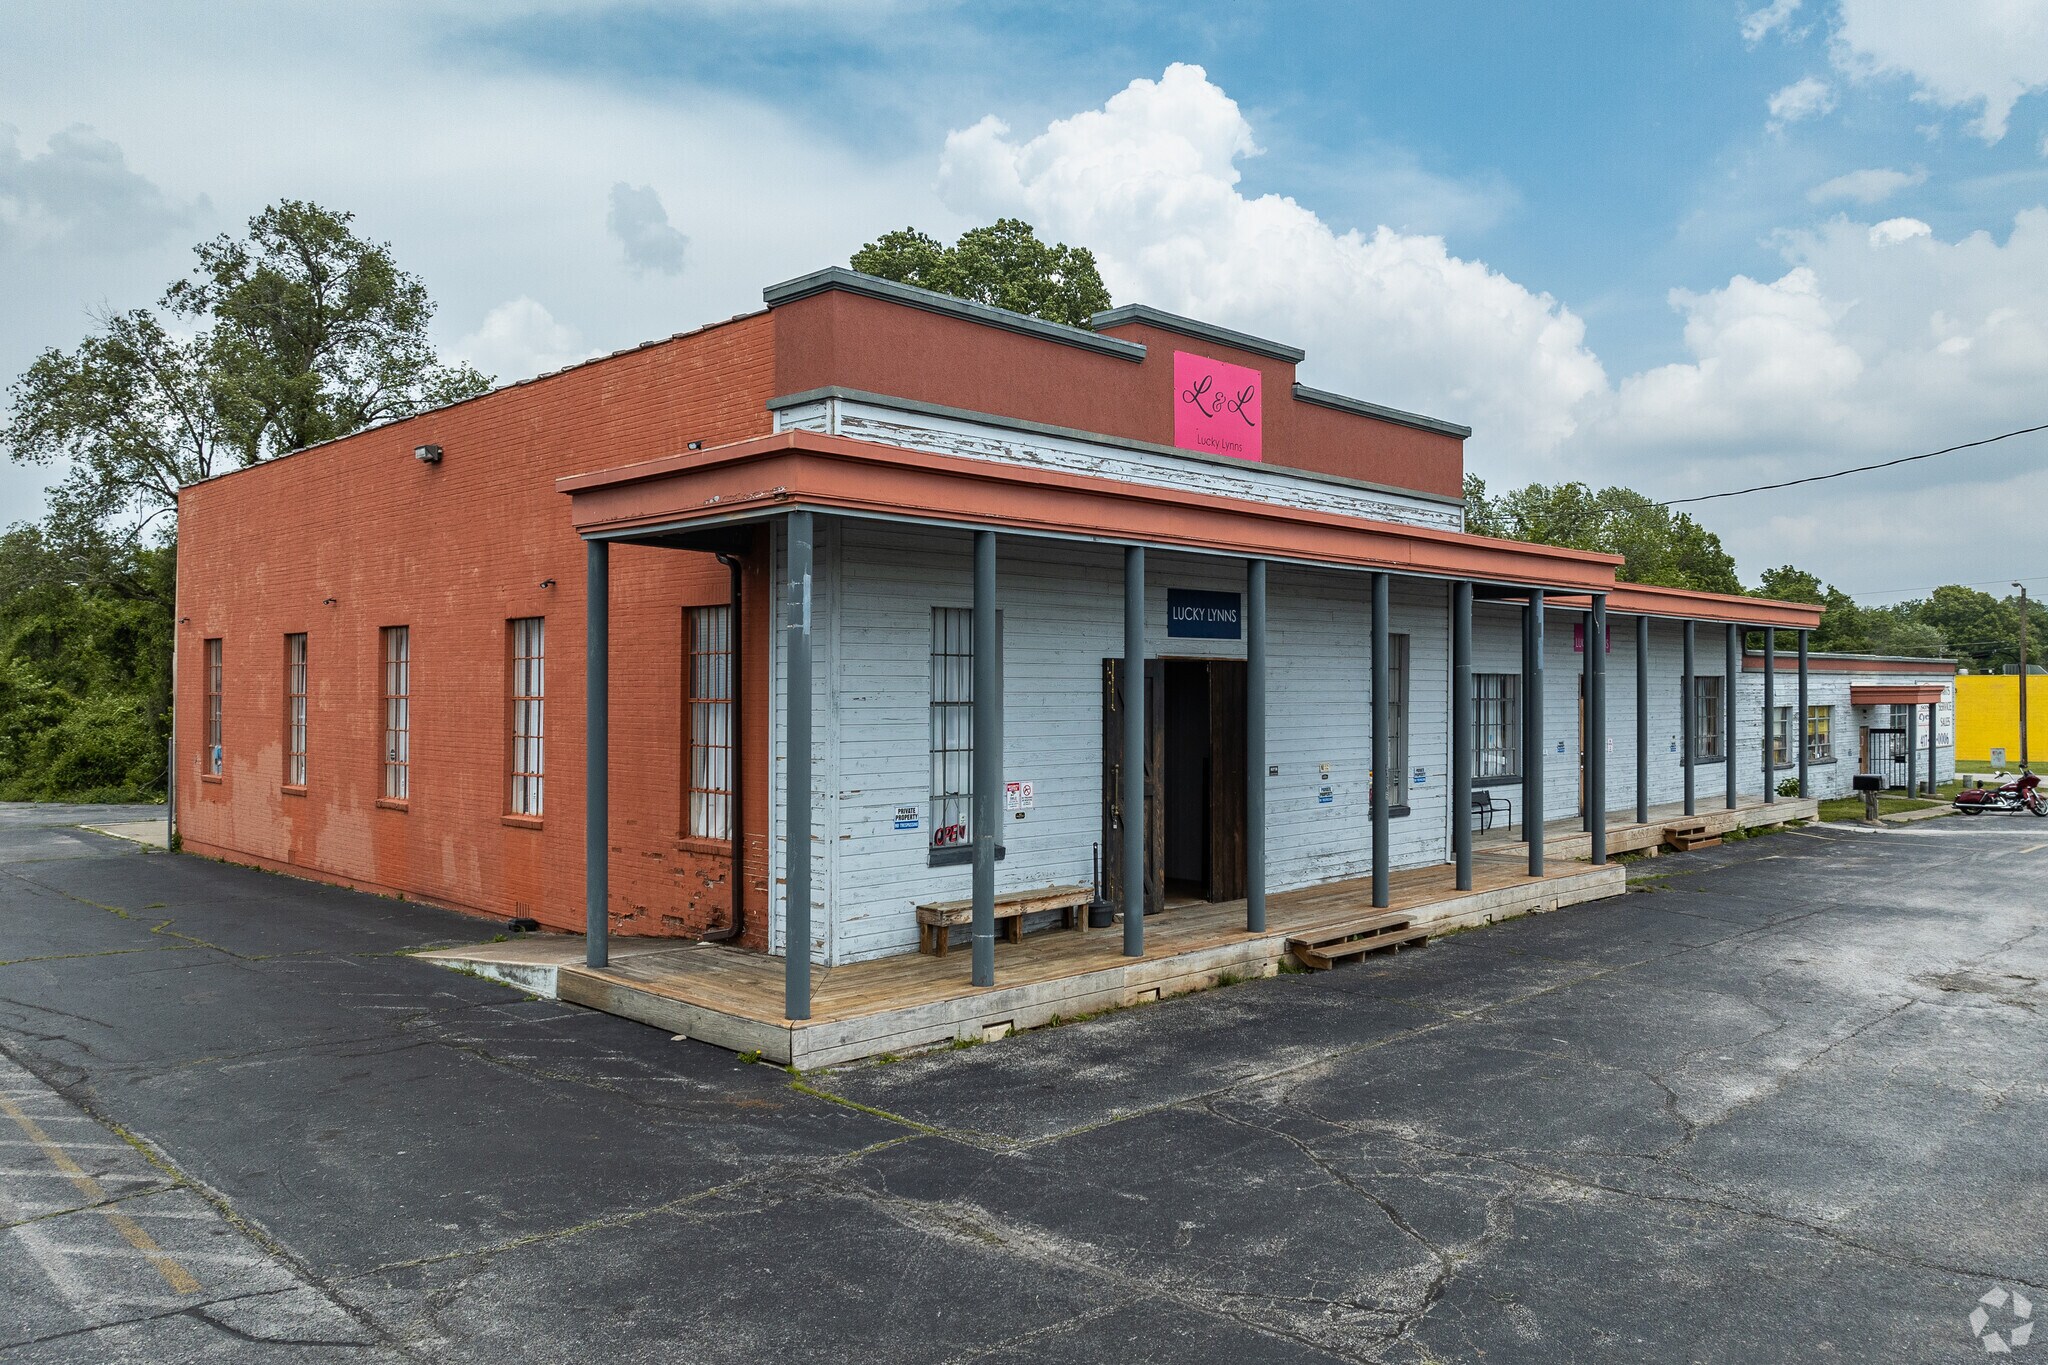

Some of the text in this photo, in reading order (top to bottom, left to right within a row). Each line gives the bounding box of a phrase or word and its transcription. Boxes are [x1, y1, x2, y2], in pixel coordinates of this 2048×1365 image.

[1183, 375, 1256, 427] L & L
[1197, 434, 1243, 452] Lucky Lynns
[1172, 606, 1237, 623] LUCKY LYNNS
[897, 807, 916, 815] PRIVATE
[934, 824, 966, 846] OPEN
